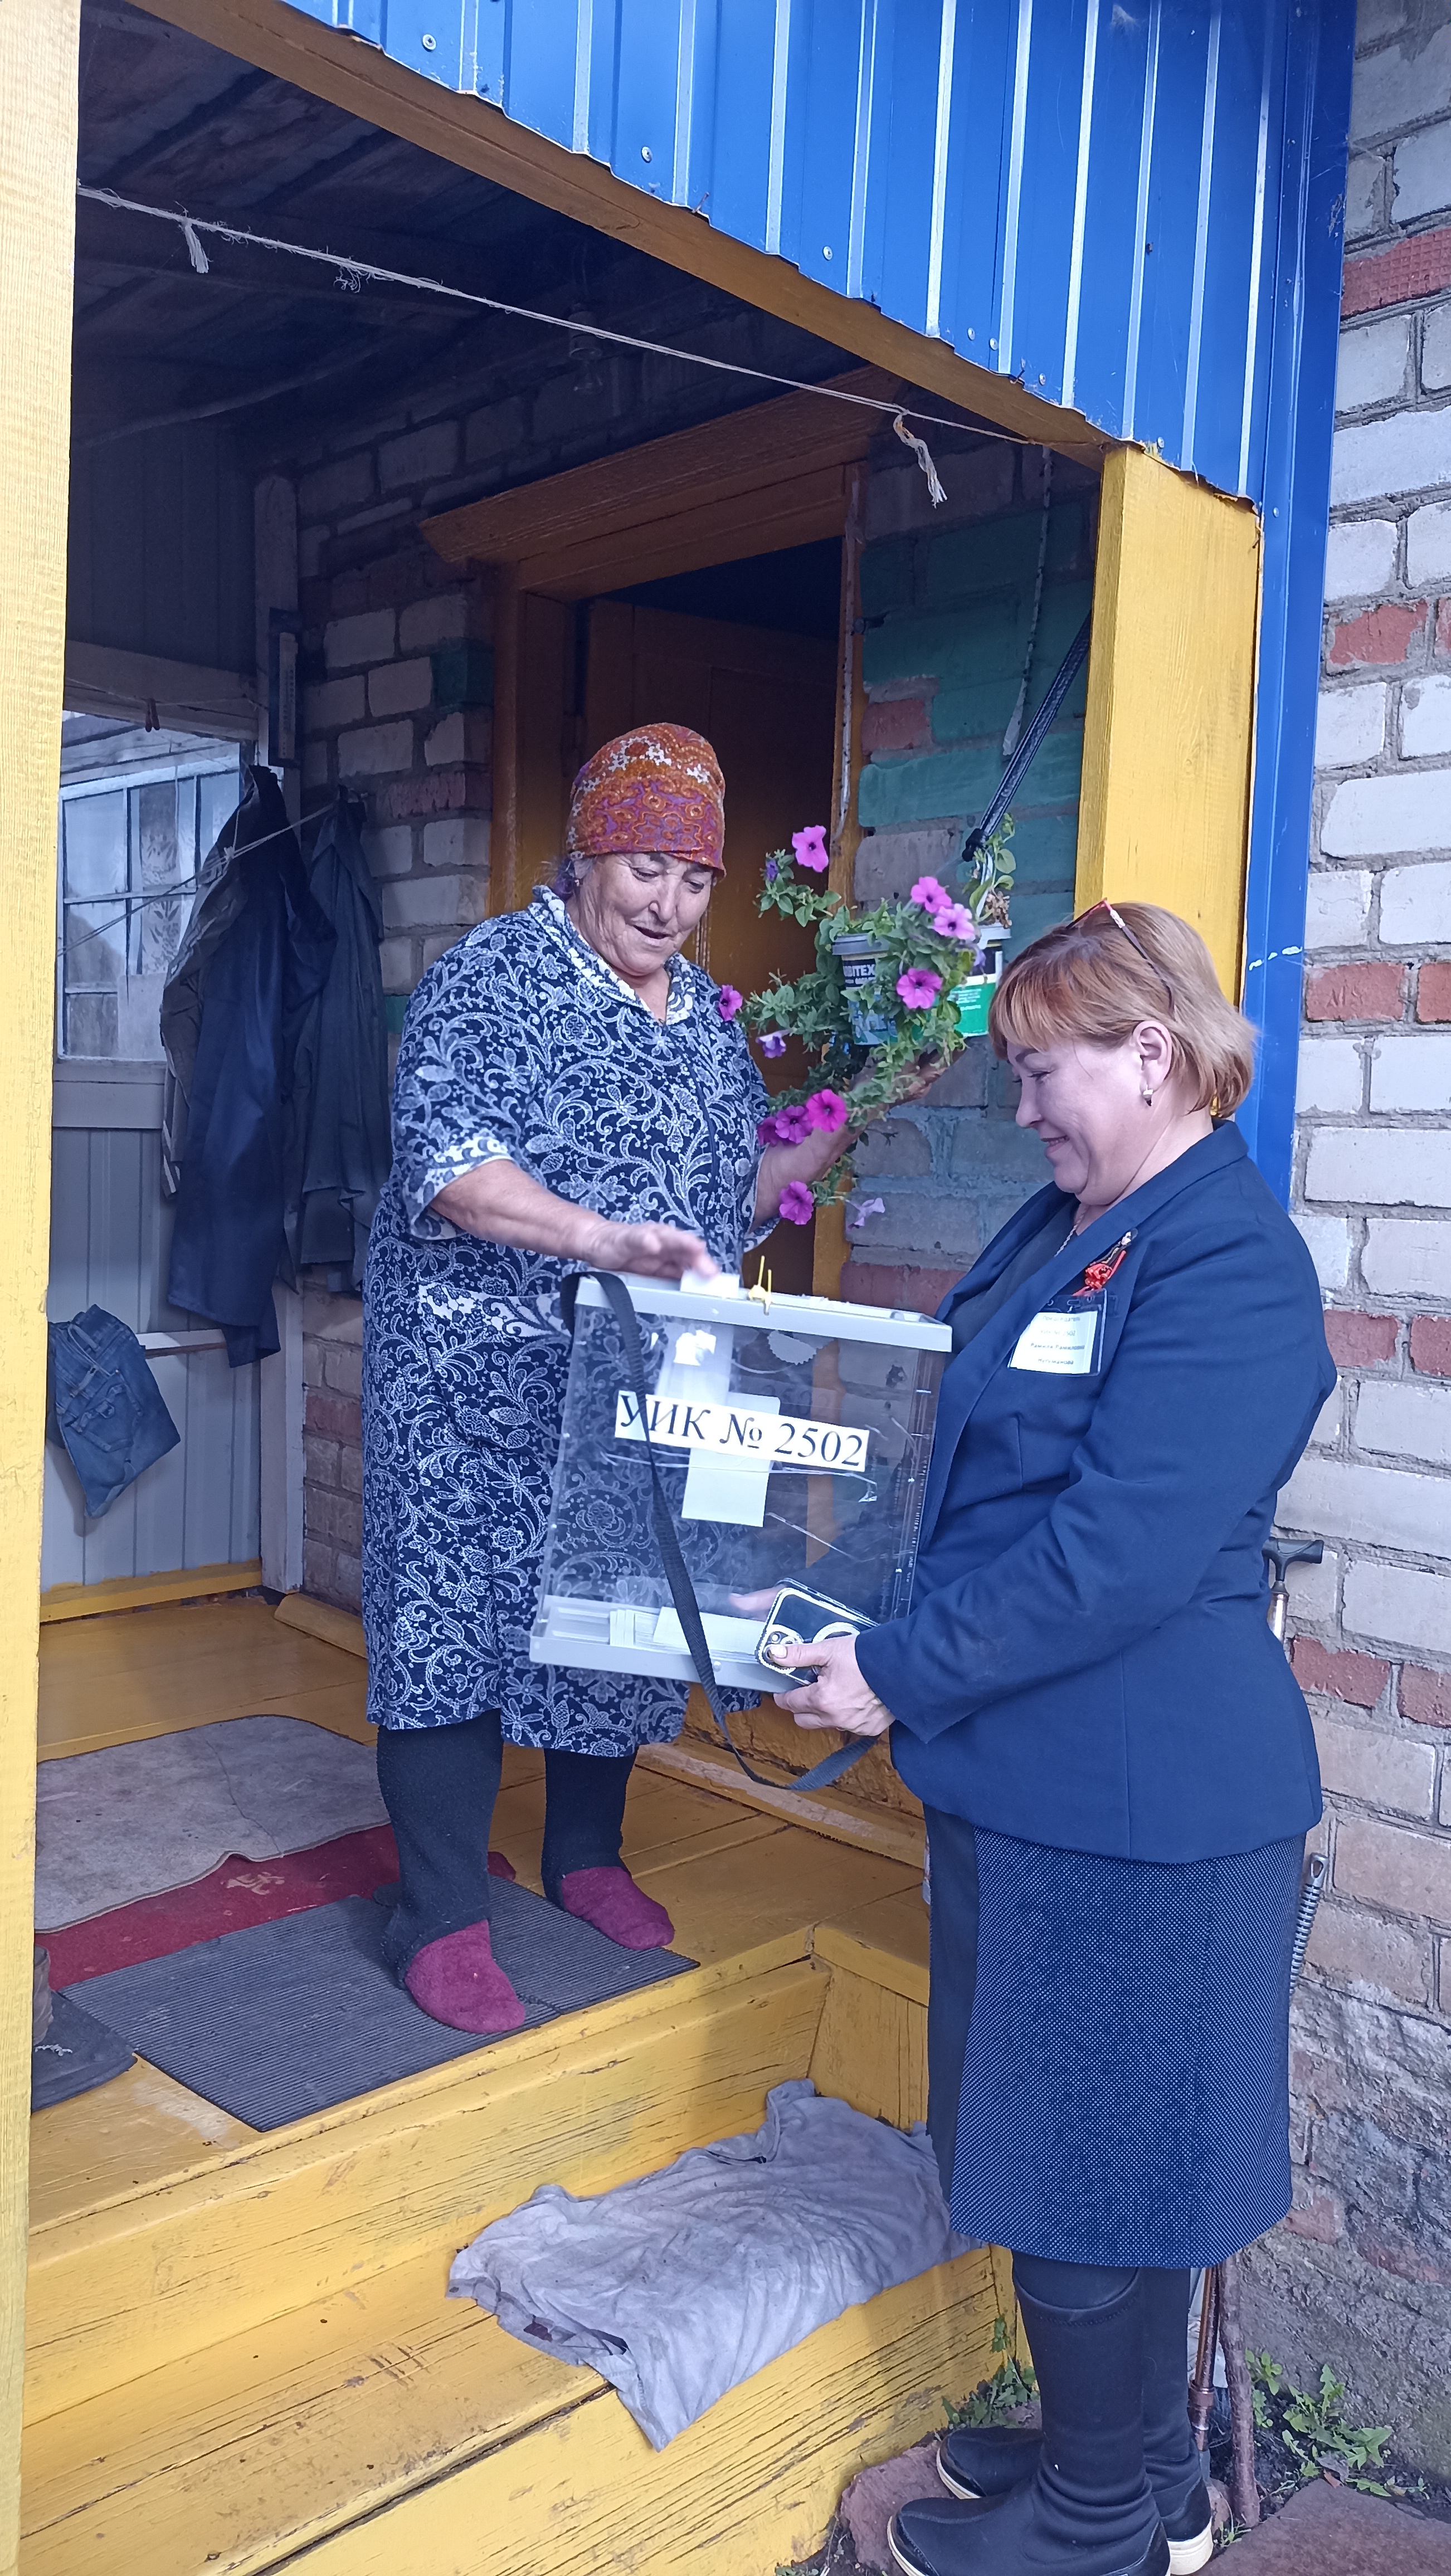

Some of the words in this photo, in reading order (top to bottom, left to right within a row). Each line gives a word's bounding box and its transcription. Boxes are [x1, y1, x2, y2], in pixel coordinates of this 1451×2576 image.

[620, 1394, 711, 1440] УИК
[719, 1413, 763, 1449] №
[774, 1423, 863, 1466] 2502
